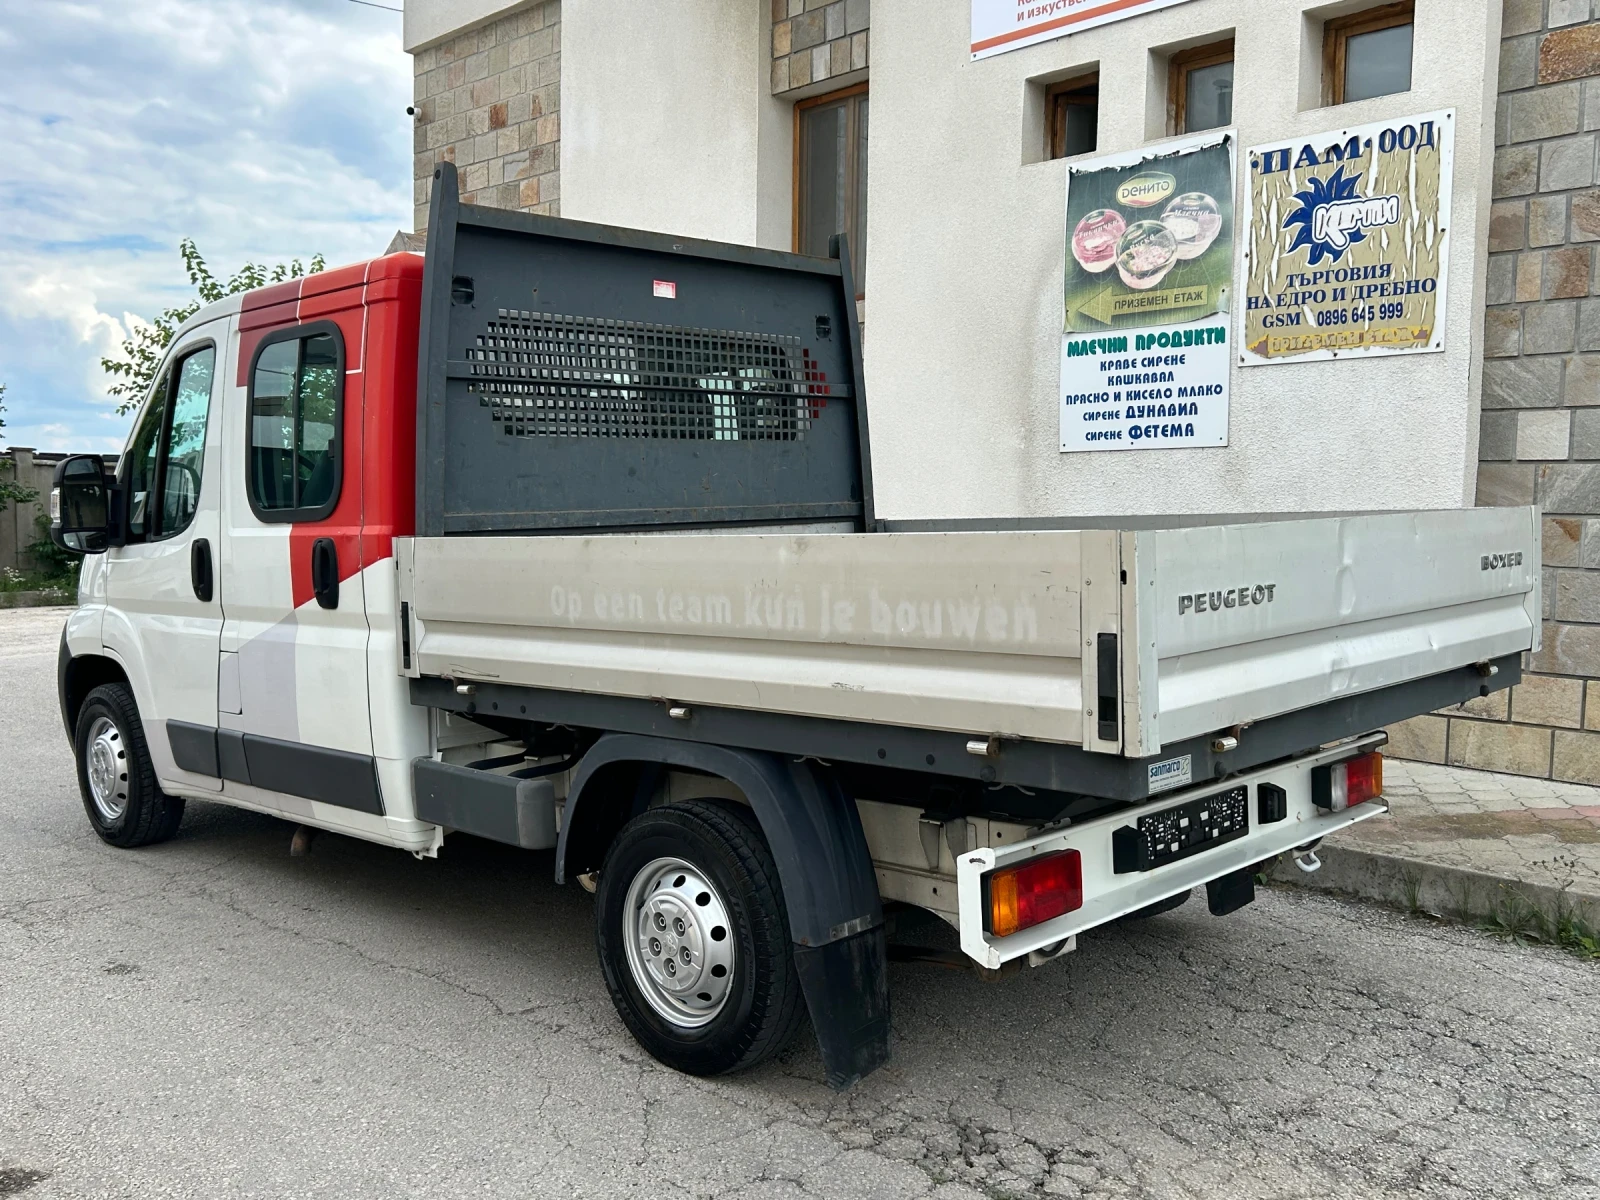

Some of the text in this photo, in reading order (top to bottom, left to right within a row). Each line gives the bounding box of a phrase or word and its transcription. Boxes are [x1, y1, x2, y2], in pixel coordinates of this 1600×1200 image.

[1017, 12, 1024, 22] и
[1379, 121, 1434, 154] ООД
[1286, 263, 1392, 288] ТЪРГОВИЯ
[1114, 290, 1203, 311] ПРИЗЕМЕН ЕТАЖ
[1247, 277, 1437, 310] НА ЕДРО И ДРЕБНО
[1262, 311, 1302, 329] GSM
[1317, 308, 1348, 327] 0896
[1379, 302, 1404, 320] 999
[1067, 326, 1226, 357] МЛЕЧНИ ПРОДУКТИ
[1100, 354, 1186, 371] КРАВЕ СИРЕНЕ
[1107, 370, 1175, 386] КАШКАВАЛ
[1066, 383, 1223, 405] ПРЯСНО И КИСЕЛО МЛЯКО
[1083, 410, 1121, 421] СИРЕНЕ
[1085, 423, 1195, 441] СИРЕНЕ ФЕТЕМА
[1481, 551, 1523, 571] BOXER
[1178, 584, 1276, 616] PEUGEOT
[551, 585, 582, 624] Op
[594, 592, 644, 623] een
[656, 587, 732, 624] team
[869, 587, 1037, 644] bouwen
[1150, 760, 1181, 778] sanmarco
